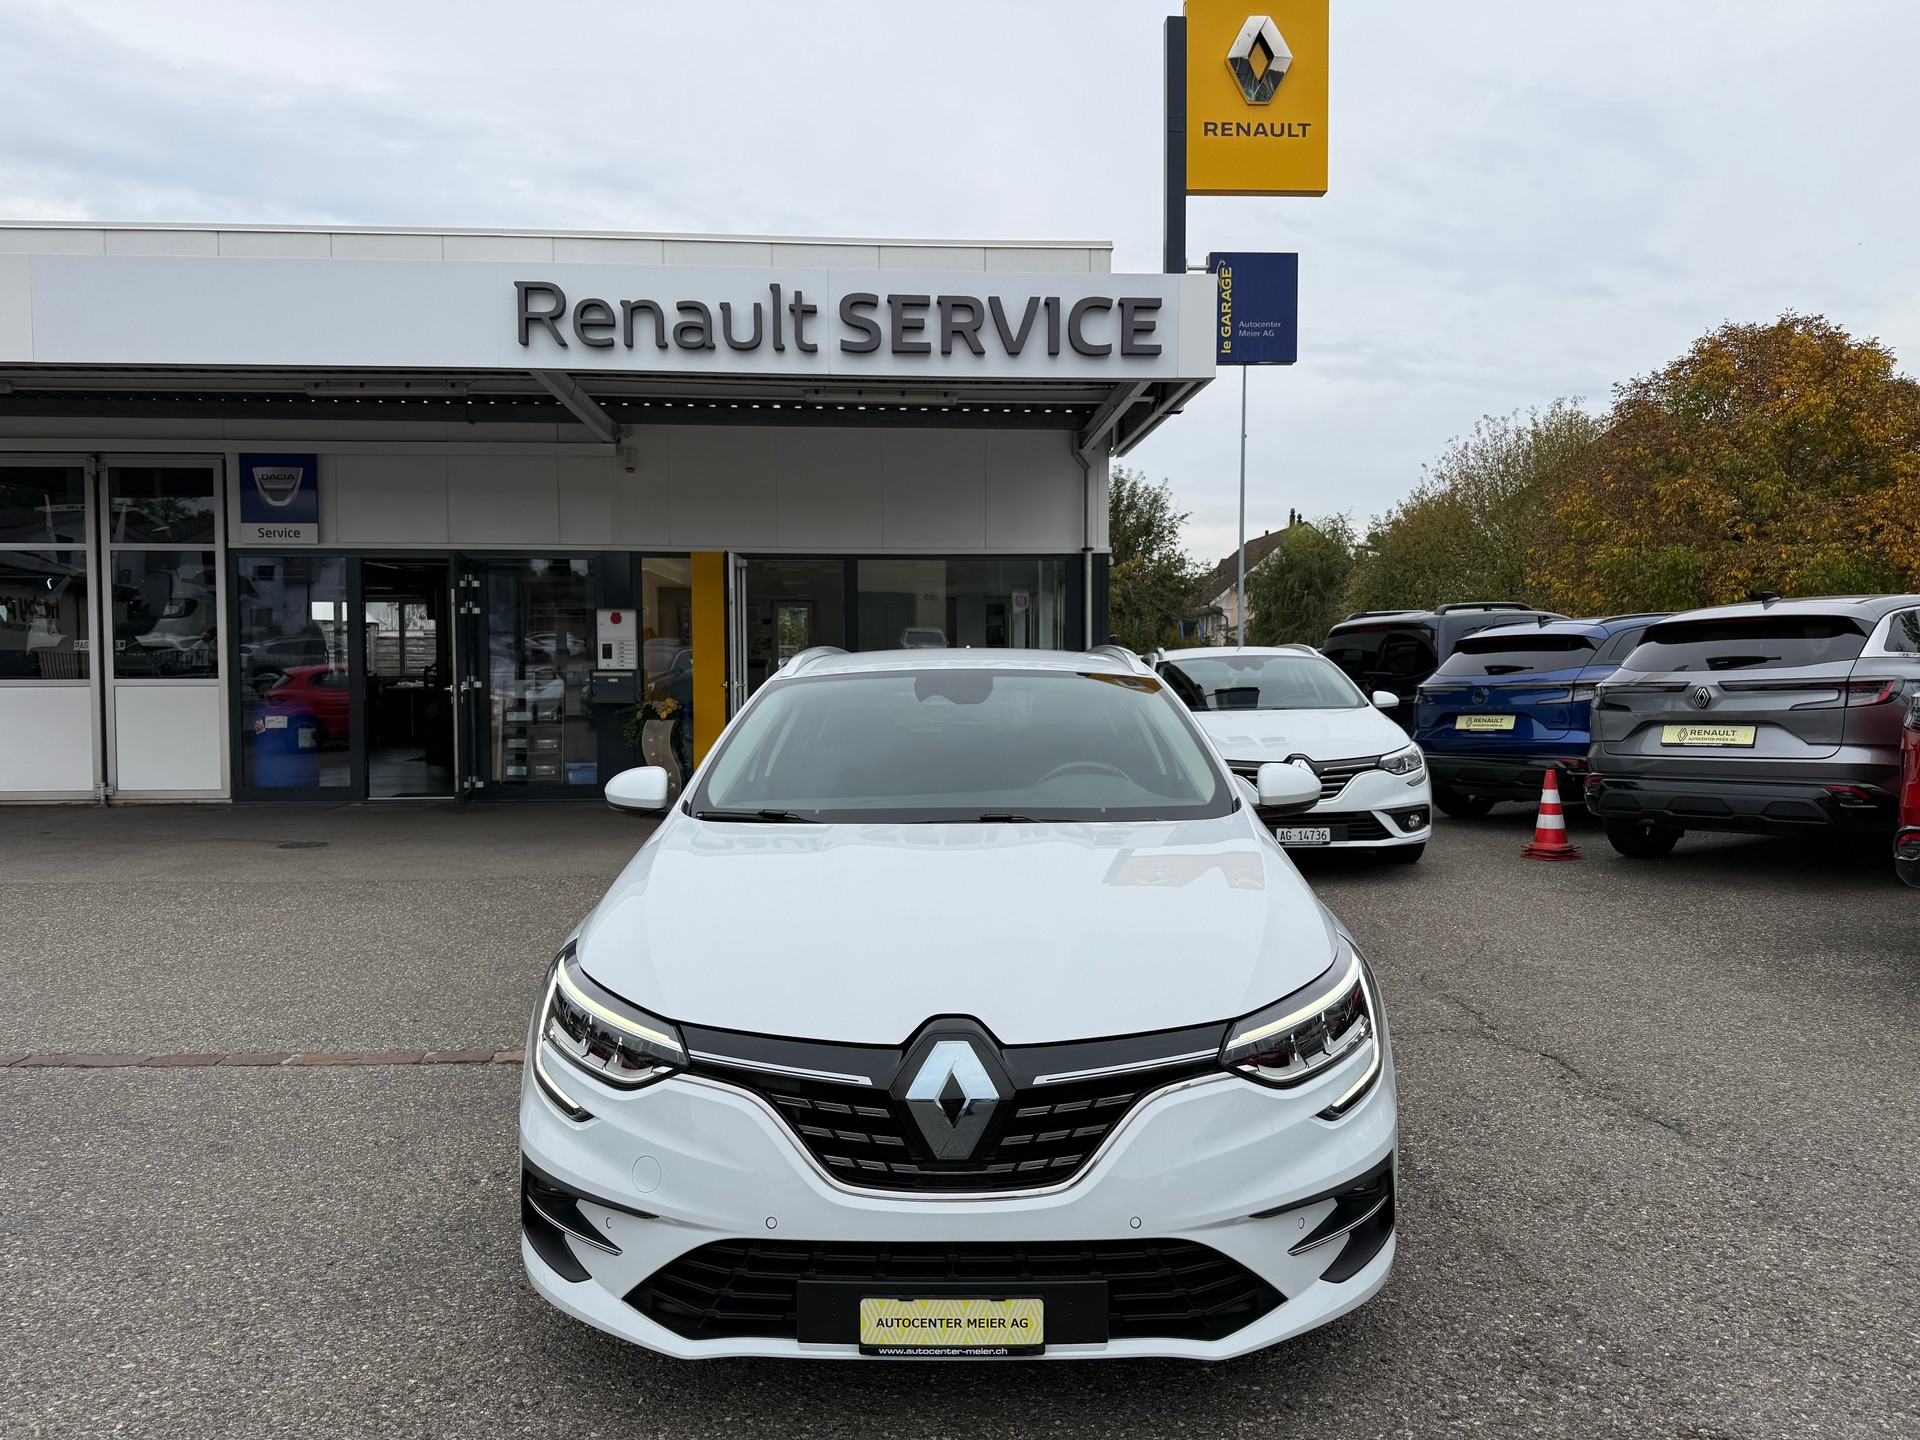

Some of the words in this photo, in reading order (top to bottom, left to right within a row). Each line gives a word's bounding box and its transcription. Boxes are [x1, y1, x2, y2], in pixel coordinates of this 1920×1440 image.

[1203, 121, 1312, 138] RENAULT
[1220, 266, 1232, 338] GARAGE
[513, 280, 818, 353] Renault
[839, 291, 1163, 357] SERVICE
[1238, 321, 1282, 329] Autocenter
[1220, 341, 1232, 354] le
[261, 473, 295, 481] DACIA
[257, 527, 301, 538] Service
[1690, 729, 1737, 737] RENAULT
[876, 1318, 963, 1329] AUTOCENTER
[967, 1318, 1006, 1329] MEIER
[1010, 1318, 1029, 1329] AG
[878, 1347, 1008, 1356] www.autocenter-meier.ch
